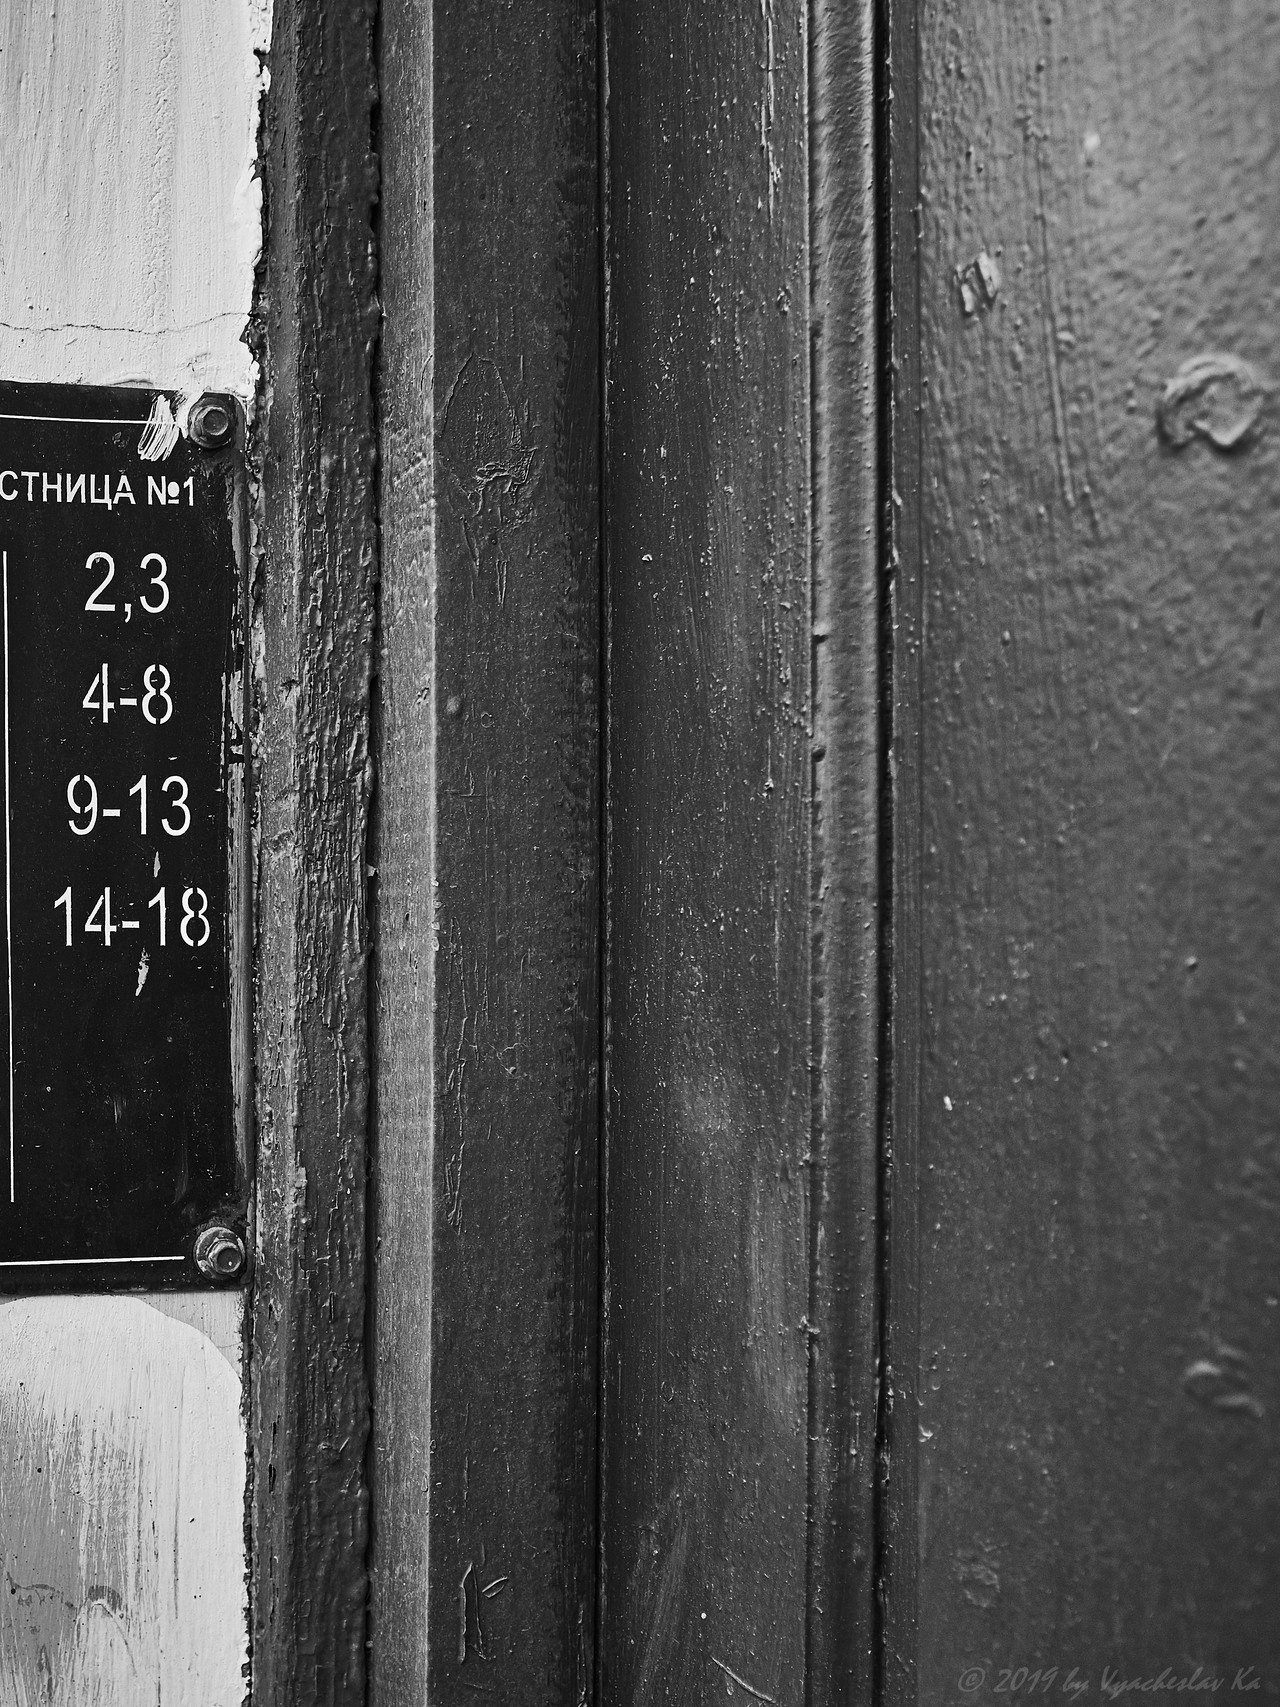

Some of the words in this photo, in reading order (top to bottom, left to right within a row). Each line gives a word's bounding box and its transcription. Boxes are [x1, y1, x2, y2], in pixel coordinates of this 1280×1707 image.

[147, 475, 194, 507] №1
[84, 551, 170, 624] 2,3
[82, 662, 173, 725] 4-8
[66, 774, 191, 837] 9-13
[53, 886, 211, 947] 14-18
